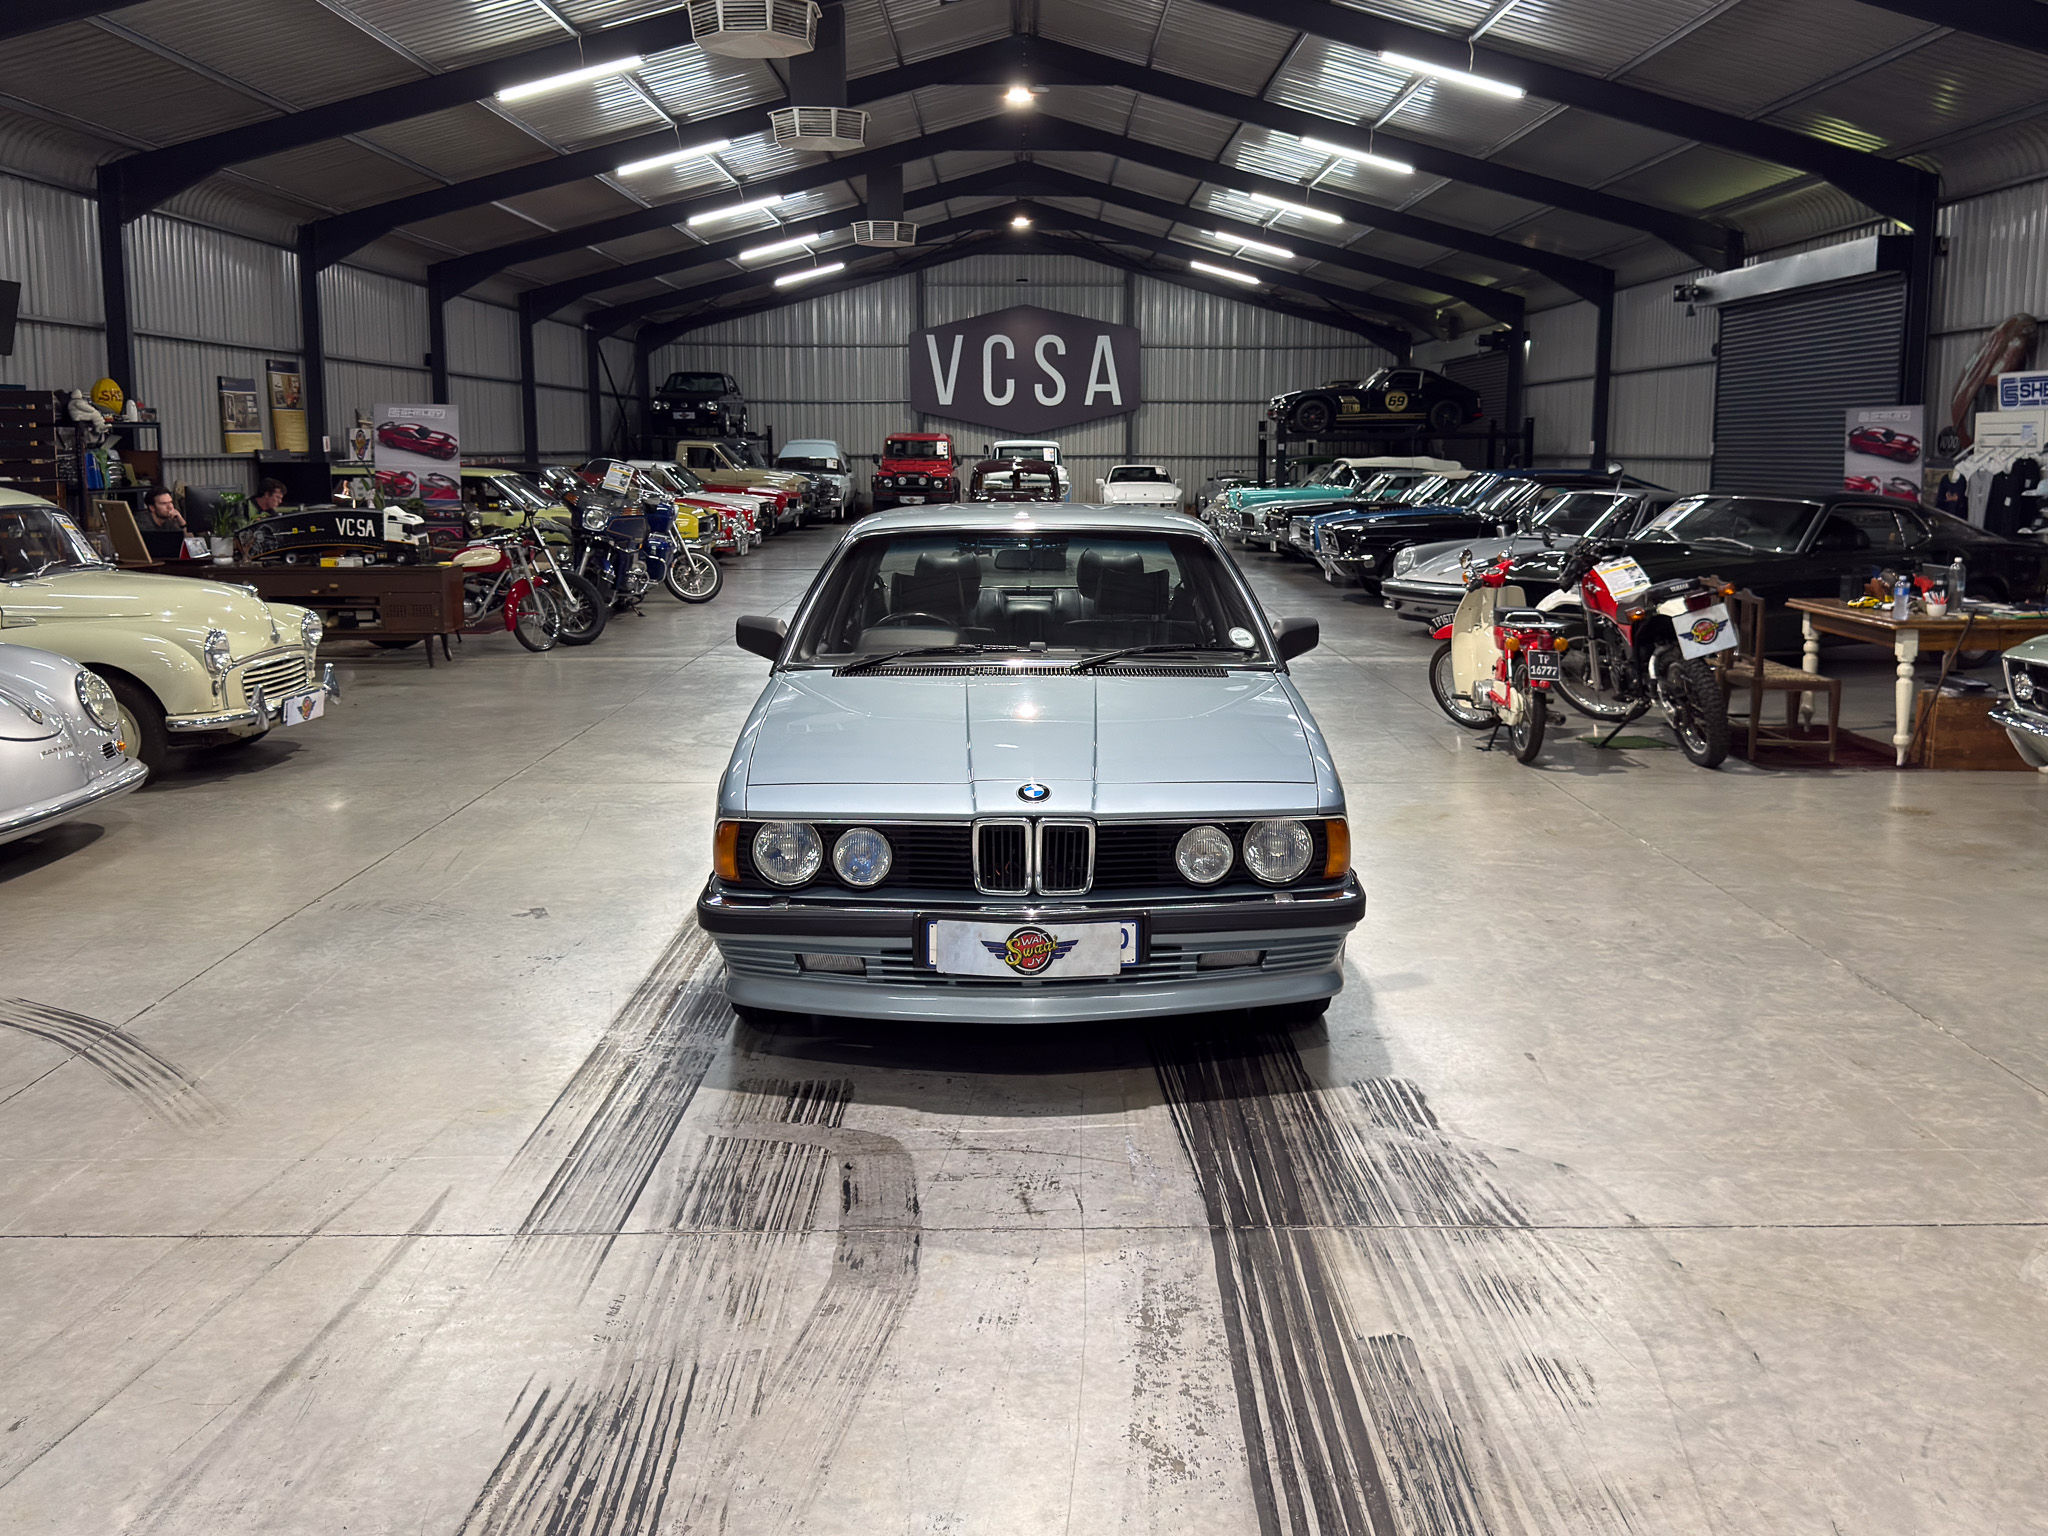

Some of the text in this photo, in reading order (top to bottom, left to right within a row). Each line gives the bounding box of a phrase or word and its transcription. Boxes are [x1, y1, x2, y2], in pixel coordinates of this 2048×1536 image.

[926, 334, 1122, 406] VCSA
[1388, 396, 1406, 407] 69
[335, 518, 376, 537] VCSA
[1584, 581, 1602, 594] XT
[1538, 654, 1550, 664] TP
[1530, 665, 1558, 676] 16777
[1021, 932, 1048, 946] WAT
[1027, 956, 1044, 966] JY
